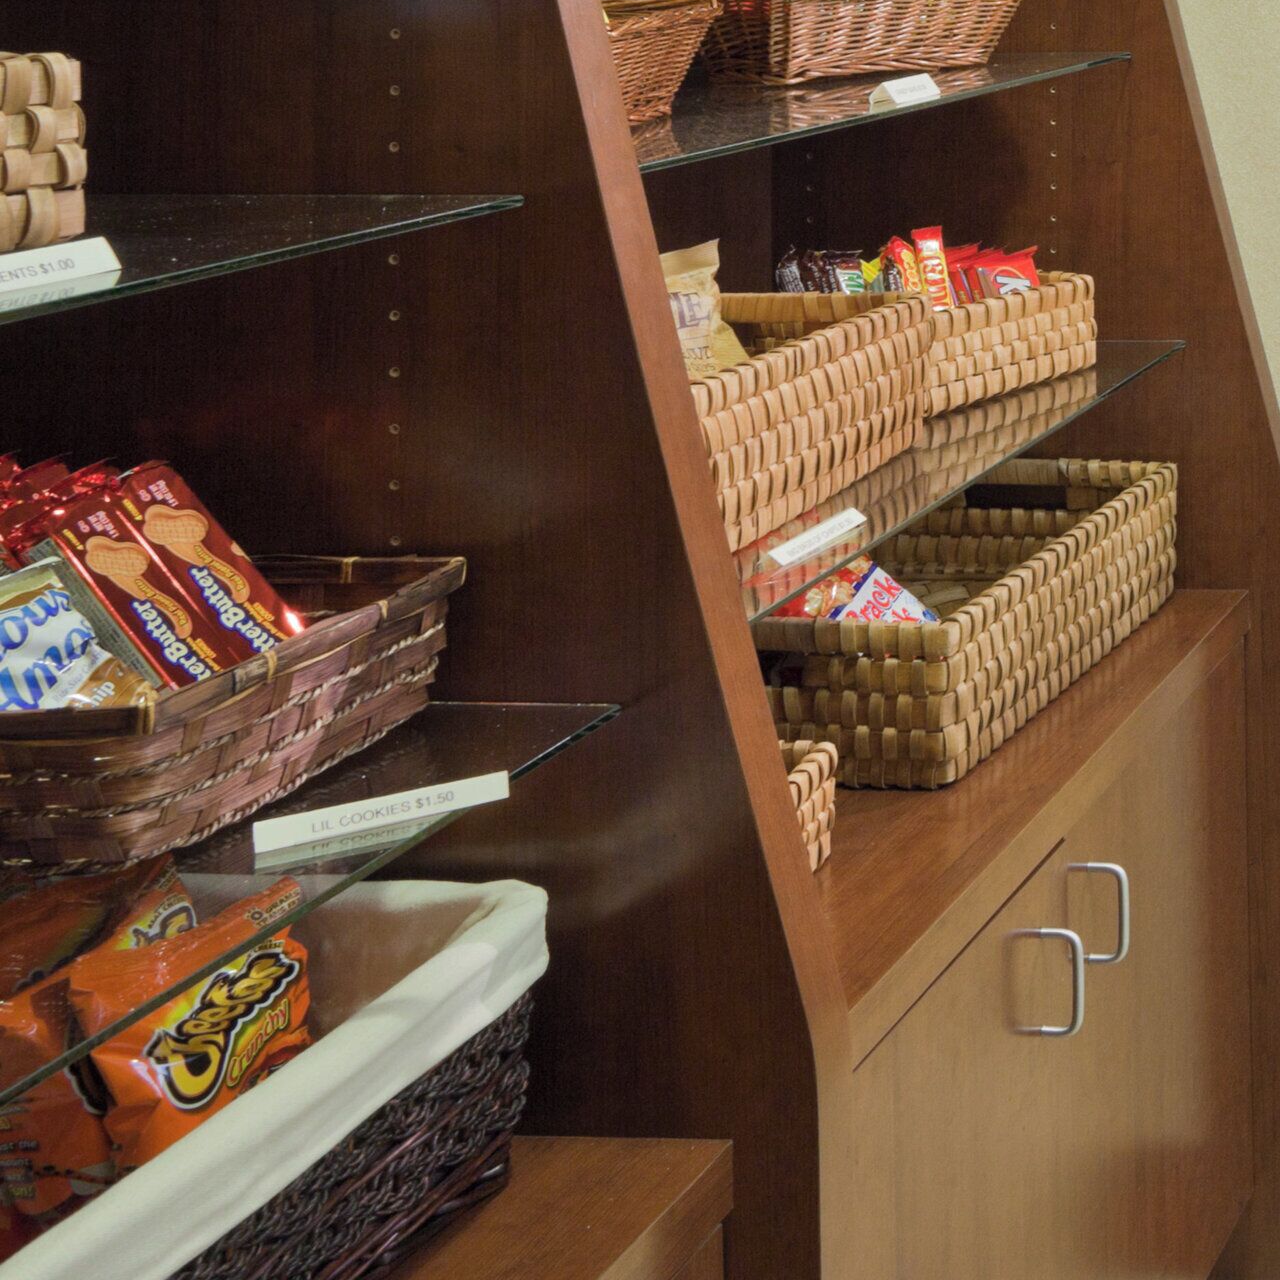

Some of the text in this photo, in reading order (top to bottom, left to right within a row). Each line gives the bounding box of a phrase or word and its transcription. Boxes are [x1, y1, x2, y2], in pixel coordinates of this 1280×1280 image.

[39, 257, 76, 275] $1.00
[0, 588, 72, 652] ous
[311, 791, 456, 834] LIL COOKIES $1.50
[226, 997, 290, 1088] Crunchy
